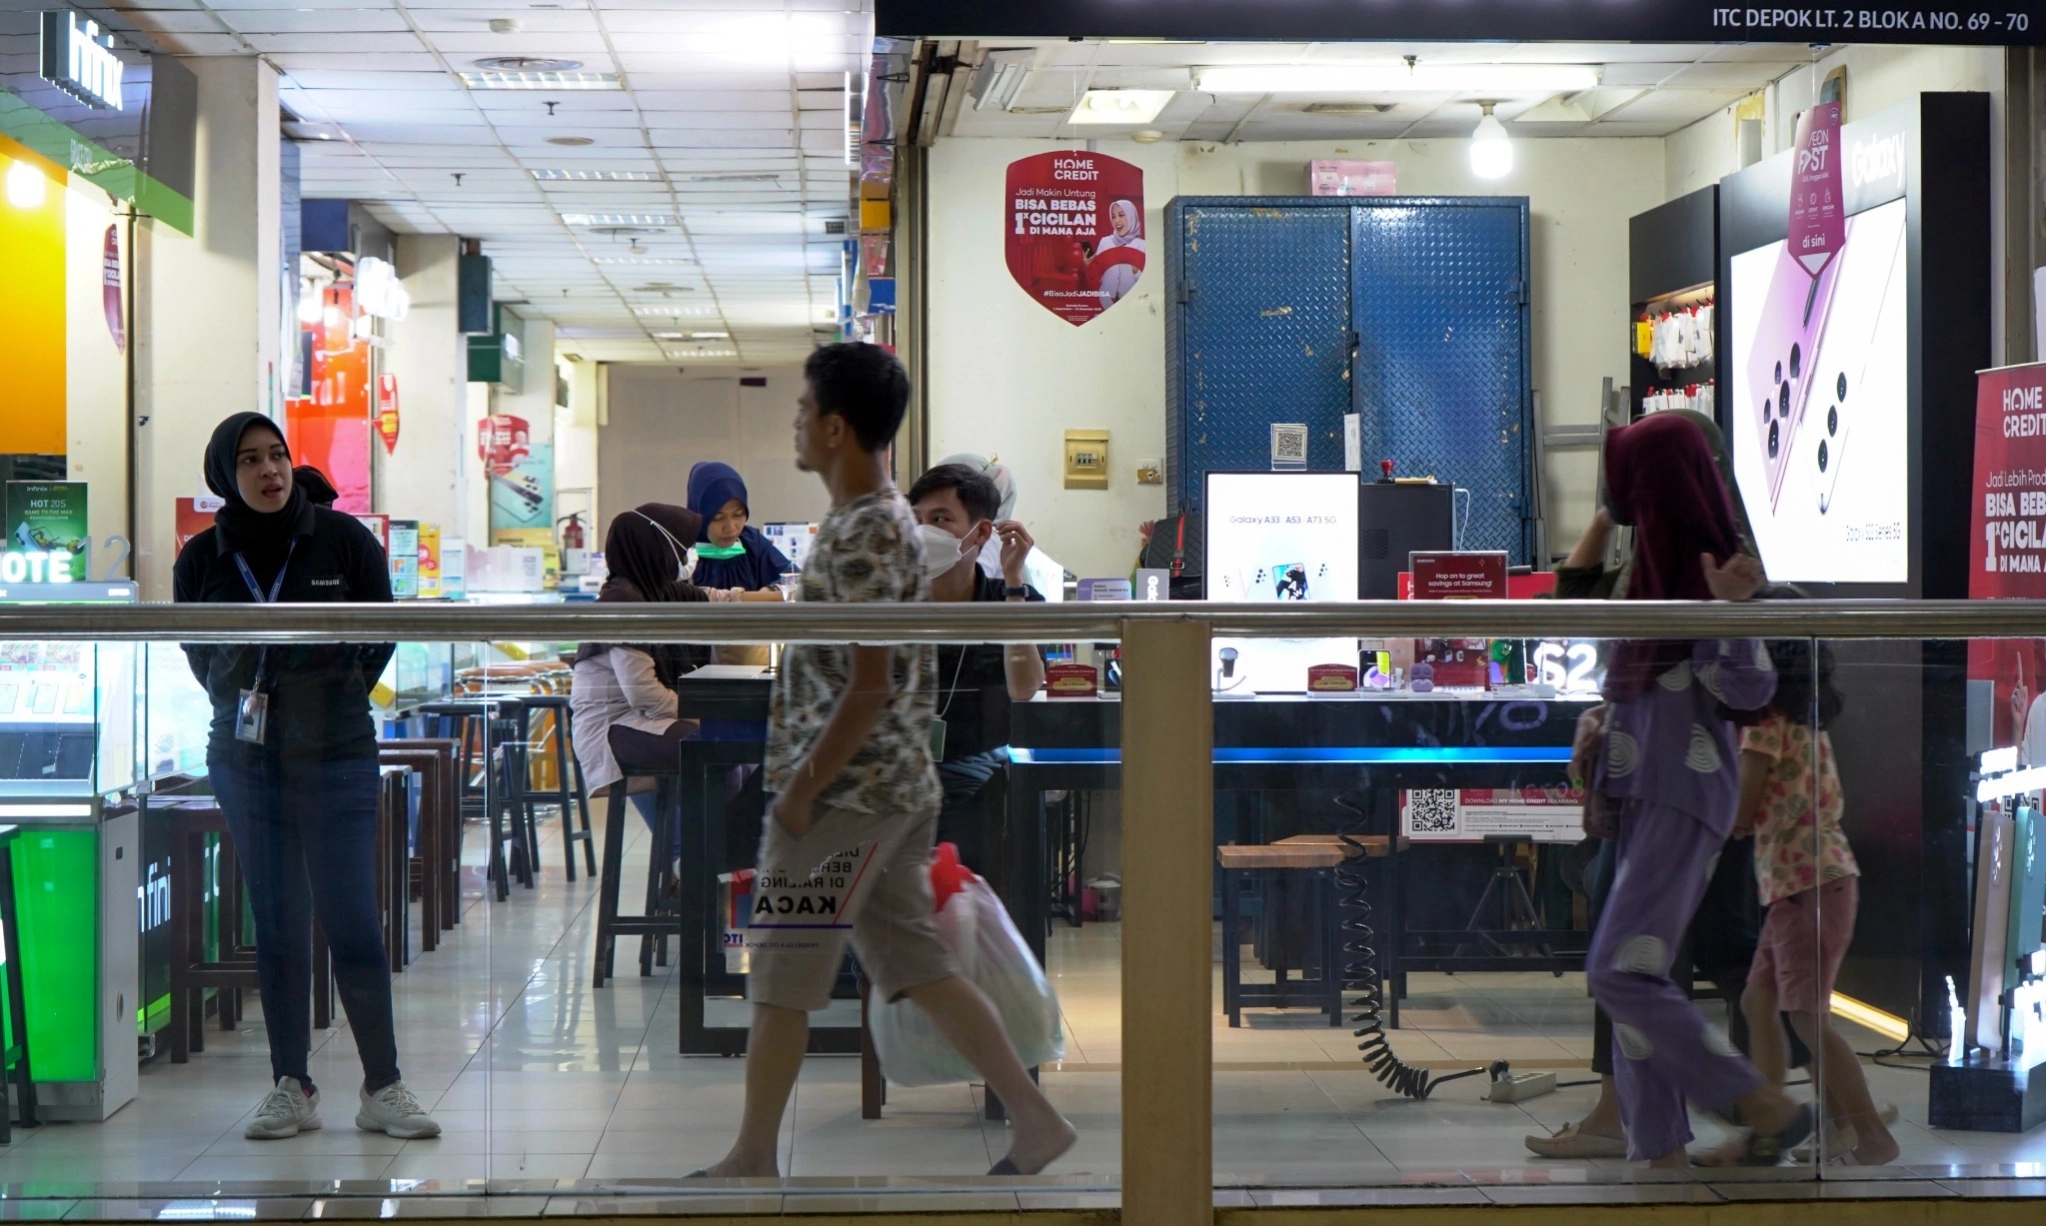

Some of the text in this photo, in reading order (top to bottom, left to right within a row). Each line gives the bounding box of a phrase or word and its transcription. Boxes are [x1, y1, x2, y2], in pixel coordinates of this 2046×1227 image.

[1713, 9, 1741, 27] ITC
[1746, 9, 1812, 28] DEPOK
[1815, 10, 1839, 28] LT.
[1843, 11, 1854, 28] 2
[1859, 11, 1910, 29] BLOK
[1911, 12, 1926, 29] A
[1930, 12, 1963, 30] NO.
[1967, 13, 1990, 31] 69
[2006, 13, 2029, 31] 70
[1054, 159, 1094, 170] HOME
[1851, 131, 1906, 189] Galaxy
[1054, 170, 1099, 181] CREDIT
[1015, 188, 1097, 200] Jadi Makin Untung
[1015, 199, 1097, 212] BISA BEBAS
[1029, 213, 1097, 226] CICILAN
[1030, 226, 1097, 236] DI MANA AJA
[1802, 233, 1826, 249] di sini
[2003, 387, 2043, 411] HOME
[1986, 471, 2003, 488] Jadi
[2004, 470, 2027, 488] Lebih
[30, 500, 49, 508] HOT
[1985, 492, 2016, 518] BISA
[1229, 515, 1337, 525] Galaxy A33 A53 A73 5G
[77, 535, 131, 581] 12
[1999, 554, 2041, 573] DI MANA
[0, 551, 73, 582] OTE
[1461, 580, 1493, 588] Samsung!
